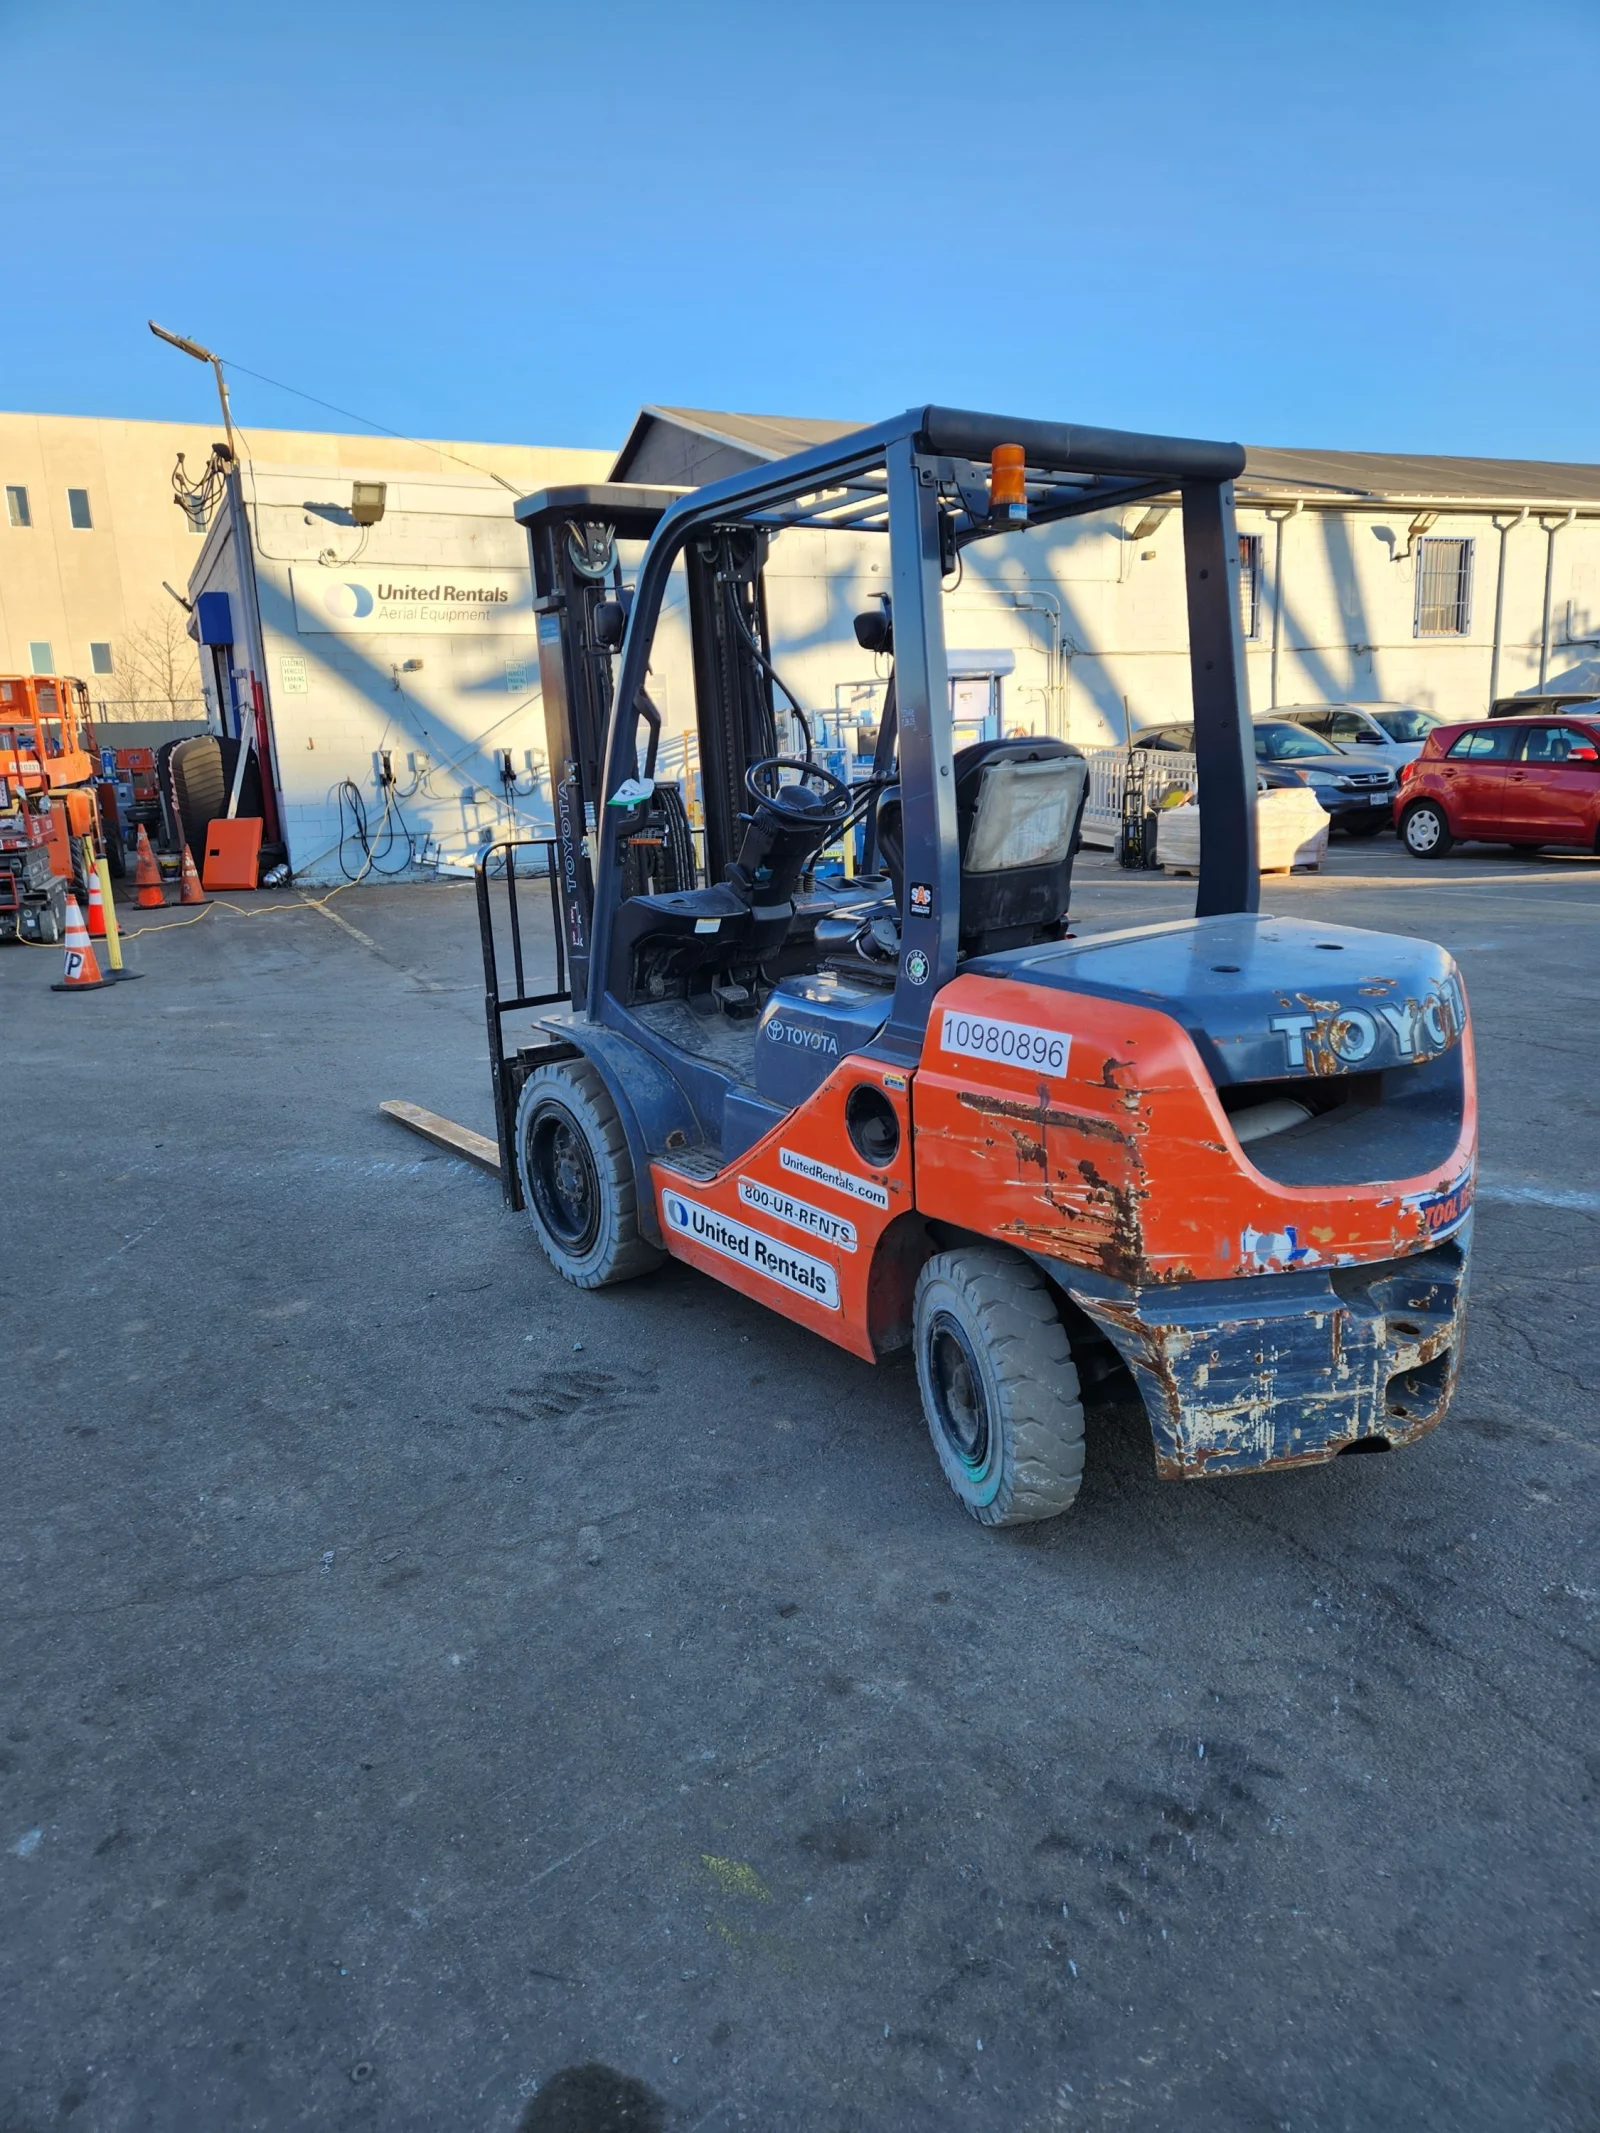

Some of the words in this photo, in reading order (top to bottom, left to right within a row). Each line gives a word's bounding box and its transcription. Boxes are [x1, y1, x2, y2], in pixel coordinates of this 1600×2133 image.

[377, 583, 441, 601] United
[443, 585, 509, 603] Rentals
[378, 606, 417, 620] Aerial
[420, 606, 491, 623] Equipment
[557, 779, 577, 893] TOYOTA
[911, 886, 931, 905] SAS
[785, 1026, 838, 1055] TOYOTA
[944, 1018, 1064, 1068] 10980896
[782, 1153, 886, 1205] UnitedRentals.com
[1425, 1196, 1458, 1228] TOOL
[692, 1211, 749, 1257] United
[755, 1240, 827, 1294] Rentals
